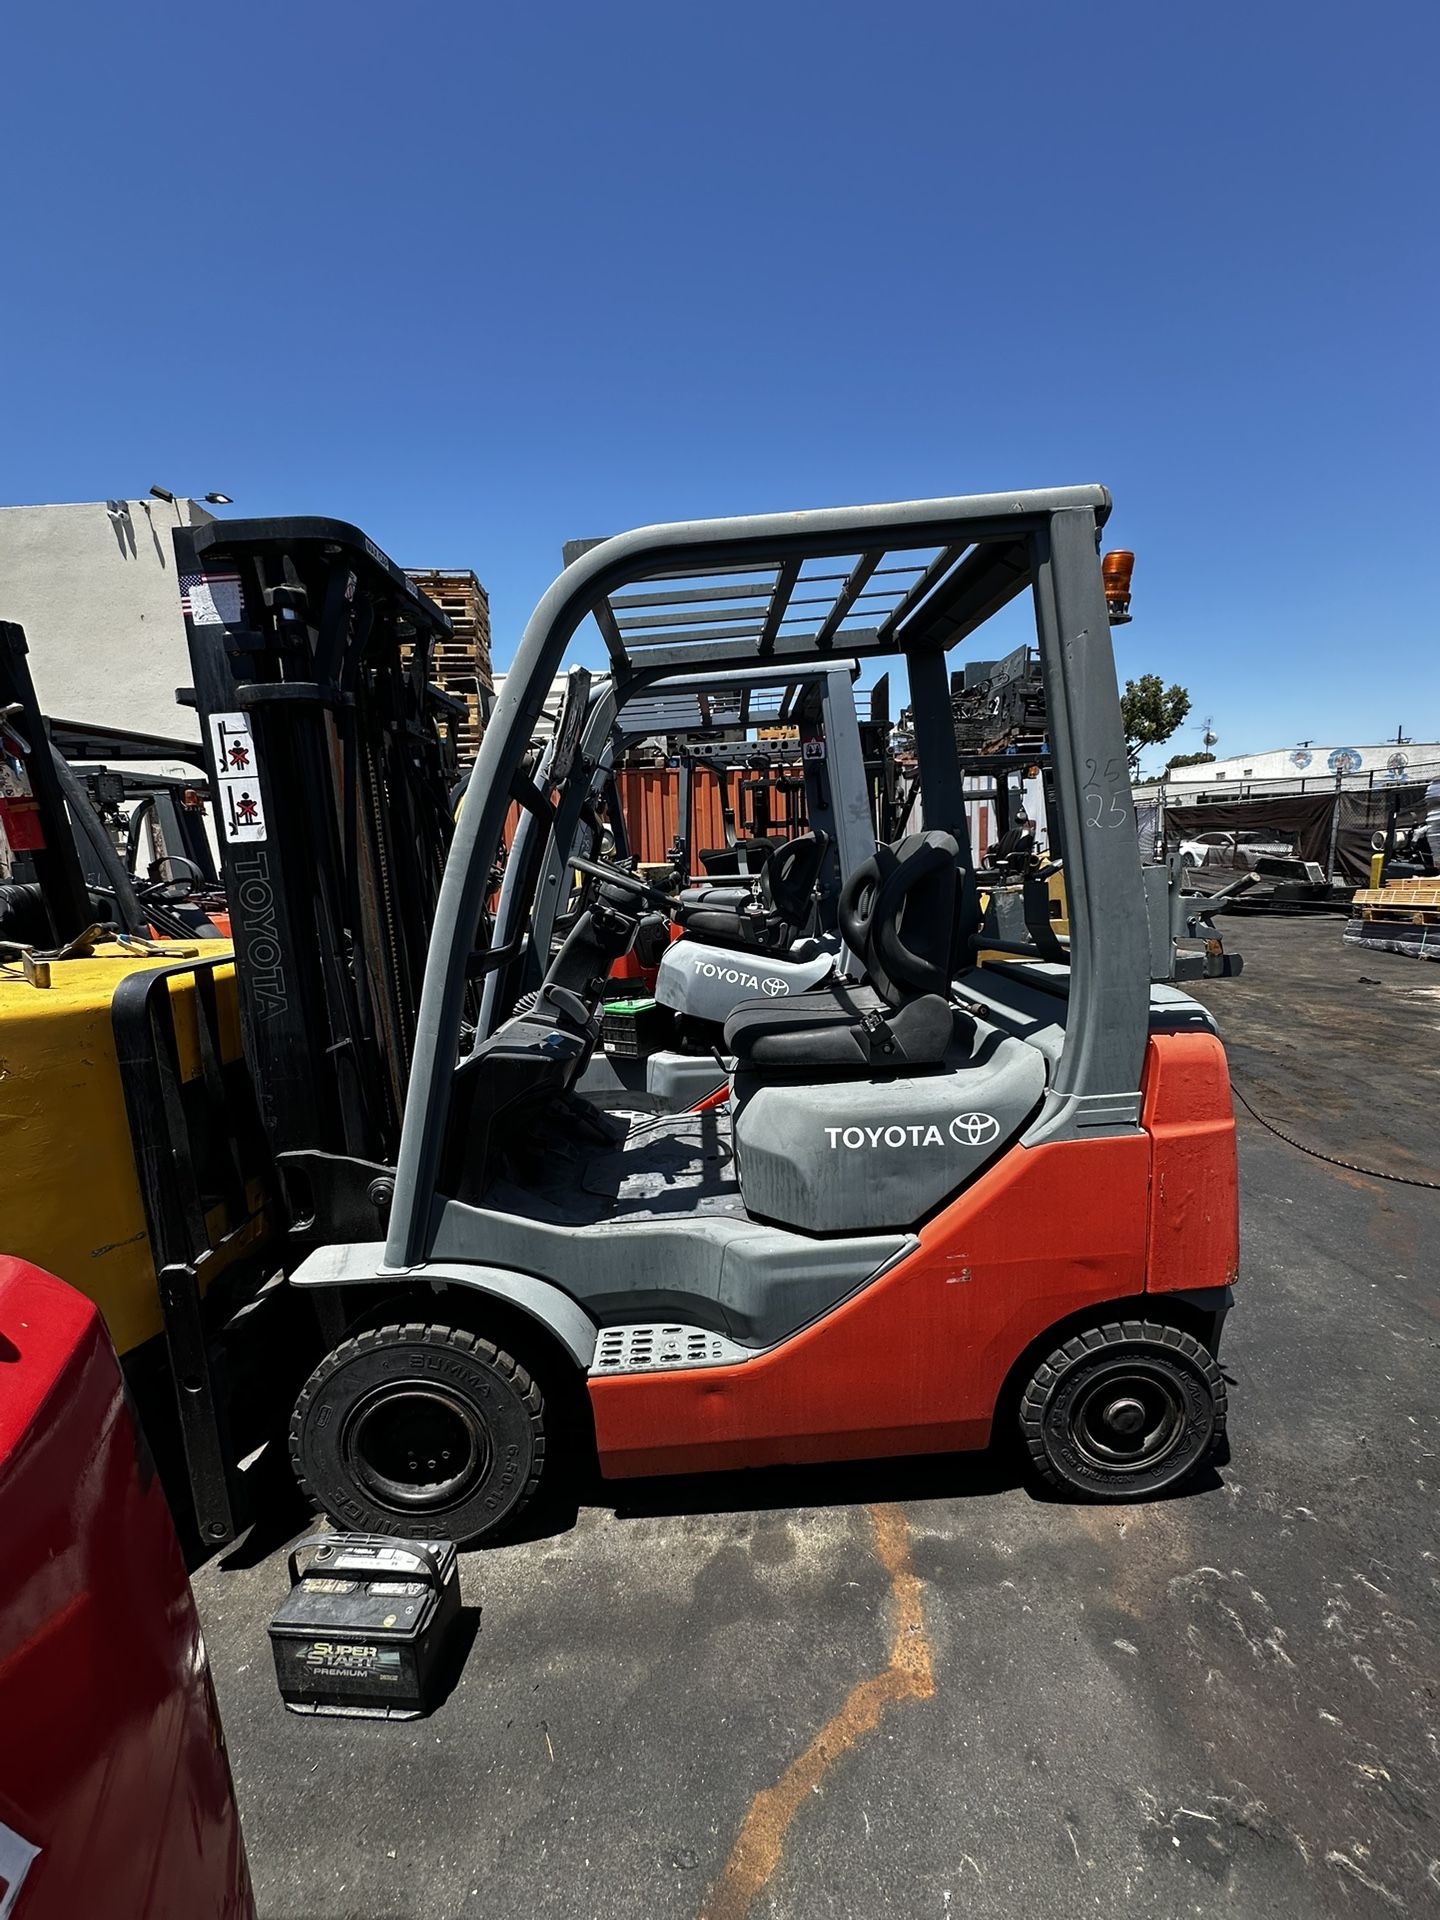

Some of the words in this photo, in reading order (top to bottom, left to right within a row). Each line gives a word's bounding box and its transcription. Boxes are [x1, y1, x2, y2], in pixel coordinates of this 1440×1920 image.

[1083, 758, 1121, 790] 25
[1086, 788, 1130, 828] 25
[234, 850, 288, 1023] TOYOTA
[694, 960, 759, 990] TOYOTA
[824, 1125, 945, 1149] TOYOTA
[409, 1353, 491, 1395] SUMMA
[484, 1443, 520, 1511] 6.50-10
[306, 1652, 378, 1668] START
[313, 1642, 378, 1657] SUPER
[313, 1667, 368, 1678] PREMIUM
